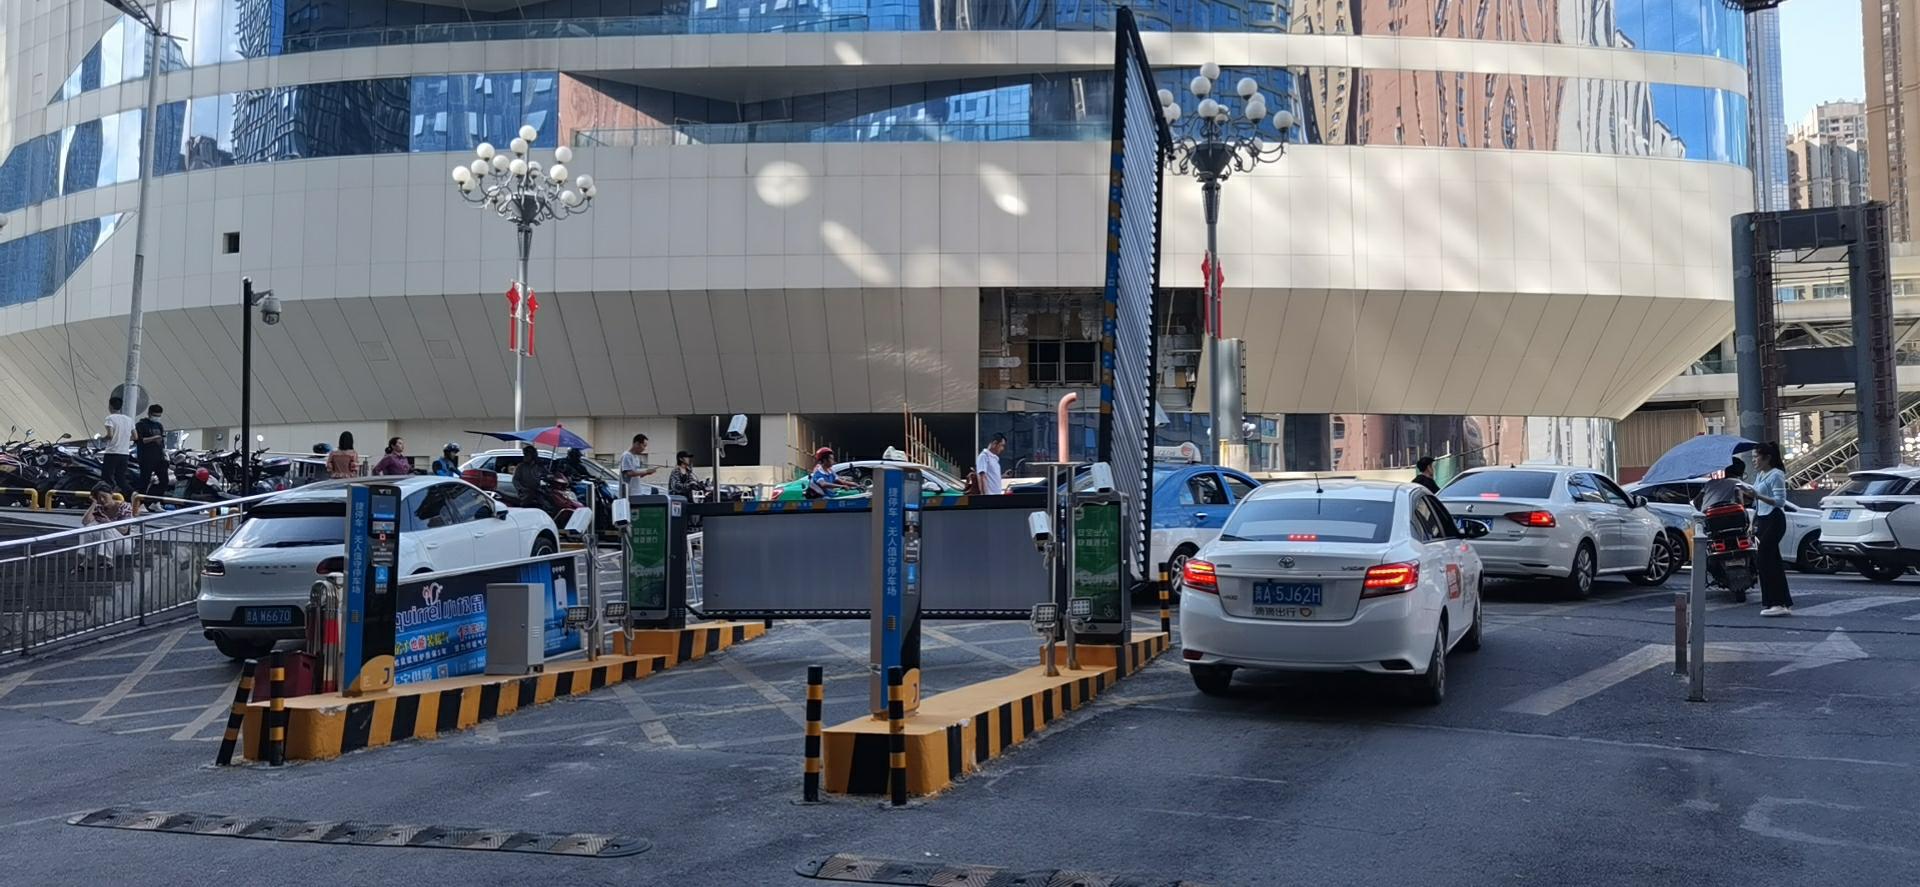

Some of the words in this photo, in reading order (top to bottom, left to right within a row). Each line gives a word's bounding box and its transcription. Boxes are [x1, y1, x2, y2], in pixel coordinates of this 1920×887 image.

[396, 599, 442, 632] quirrel
[443, 594, 484, 619] 小松鼠
